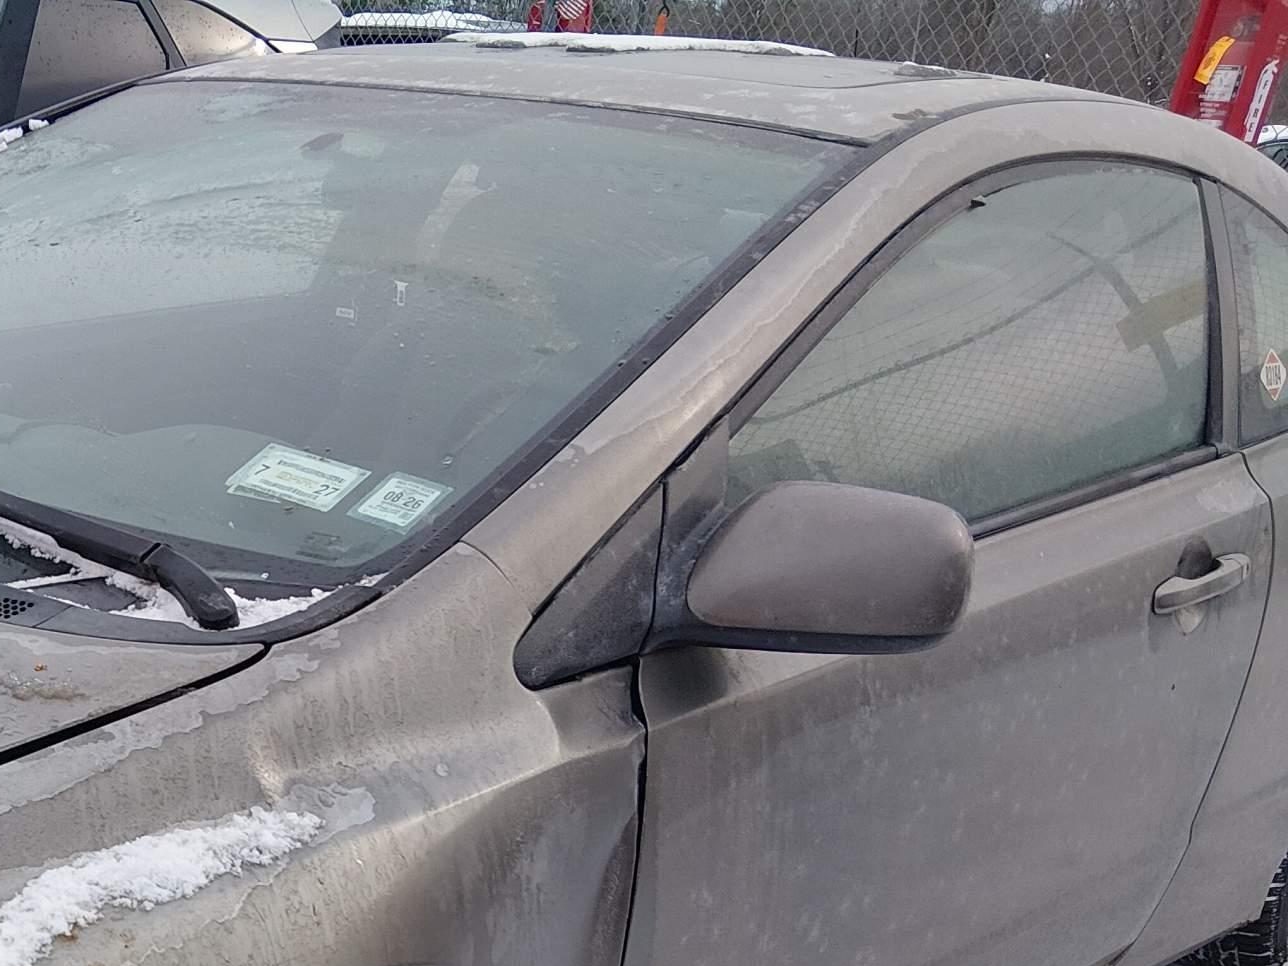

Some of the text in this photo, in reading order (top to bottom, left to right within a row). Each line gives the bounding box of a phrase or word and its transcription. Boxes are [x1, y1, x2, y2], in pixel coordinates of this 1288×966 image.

[1248, 79, 1269, 133] FIRE
[254, 463, 271, 476] 7
[313, 484, 341, 497] 27
